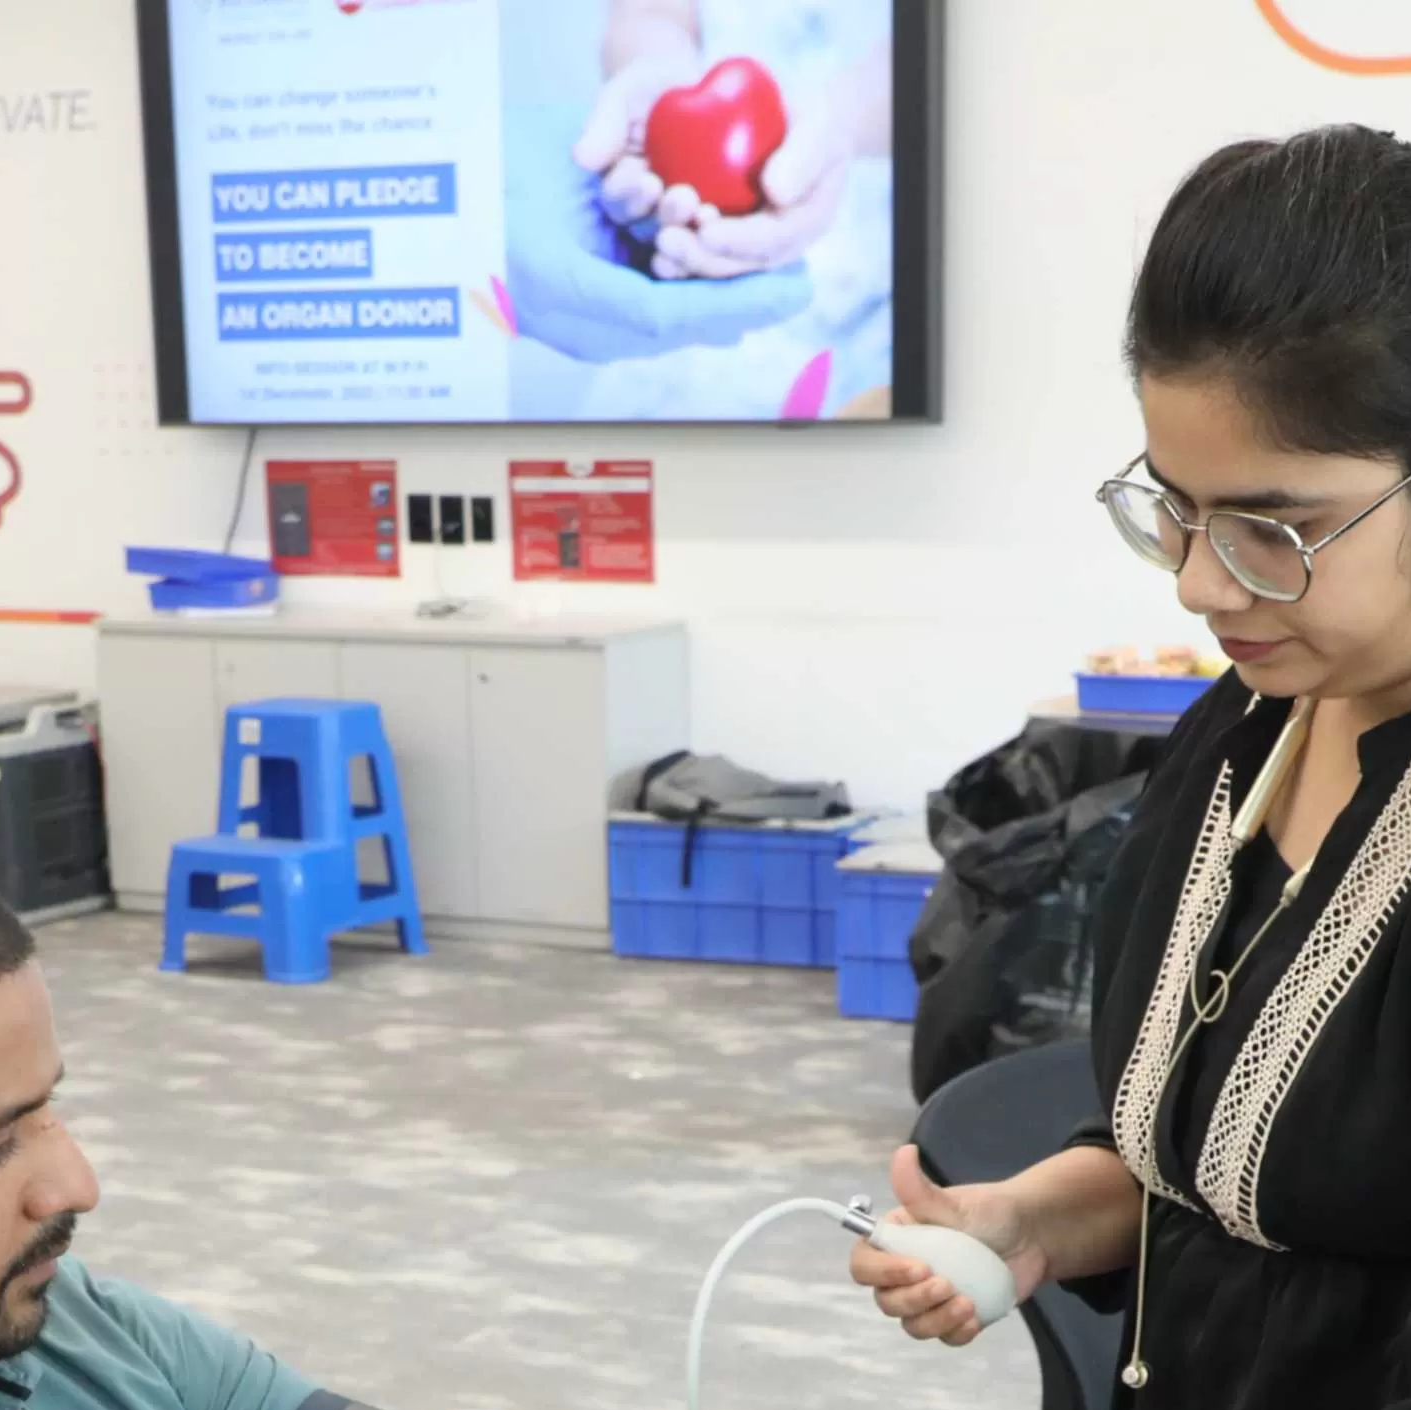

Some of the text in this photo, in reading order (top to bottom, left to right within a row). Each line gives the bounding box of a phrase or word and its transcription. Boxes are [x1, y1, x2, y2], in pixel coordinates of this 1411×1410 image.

[214, 175, 439, 211] YOU CAN PLEDGE
[219, 239, 368, 271] TO BECOME
[222, 298, 454, 329] AN ORGAN DONOR
